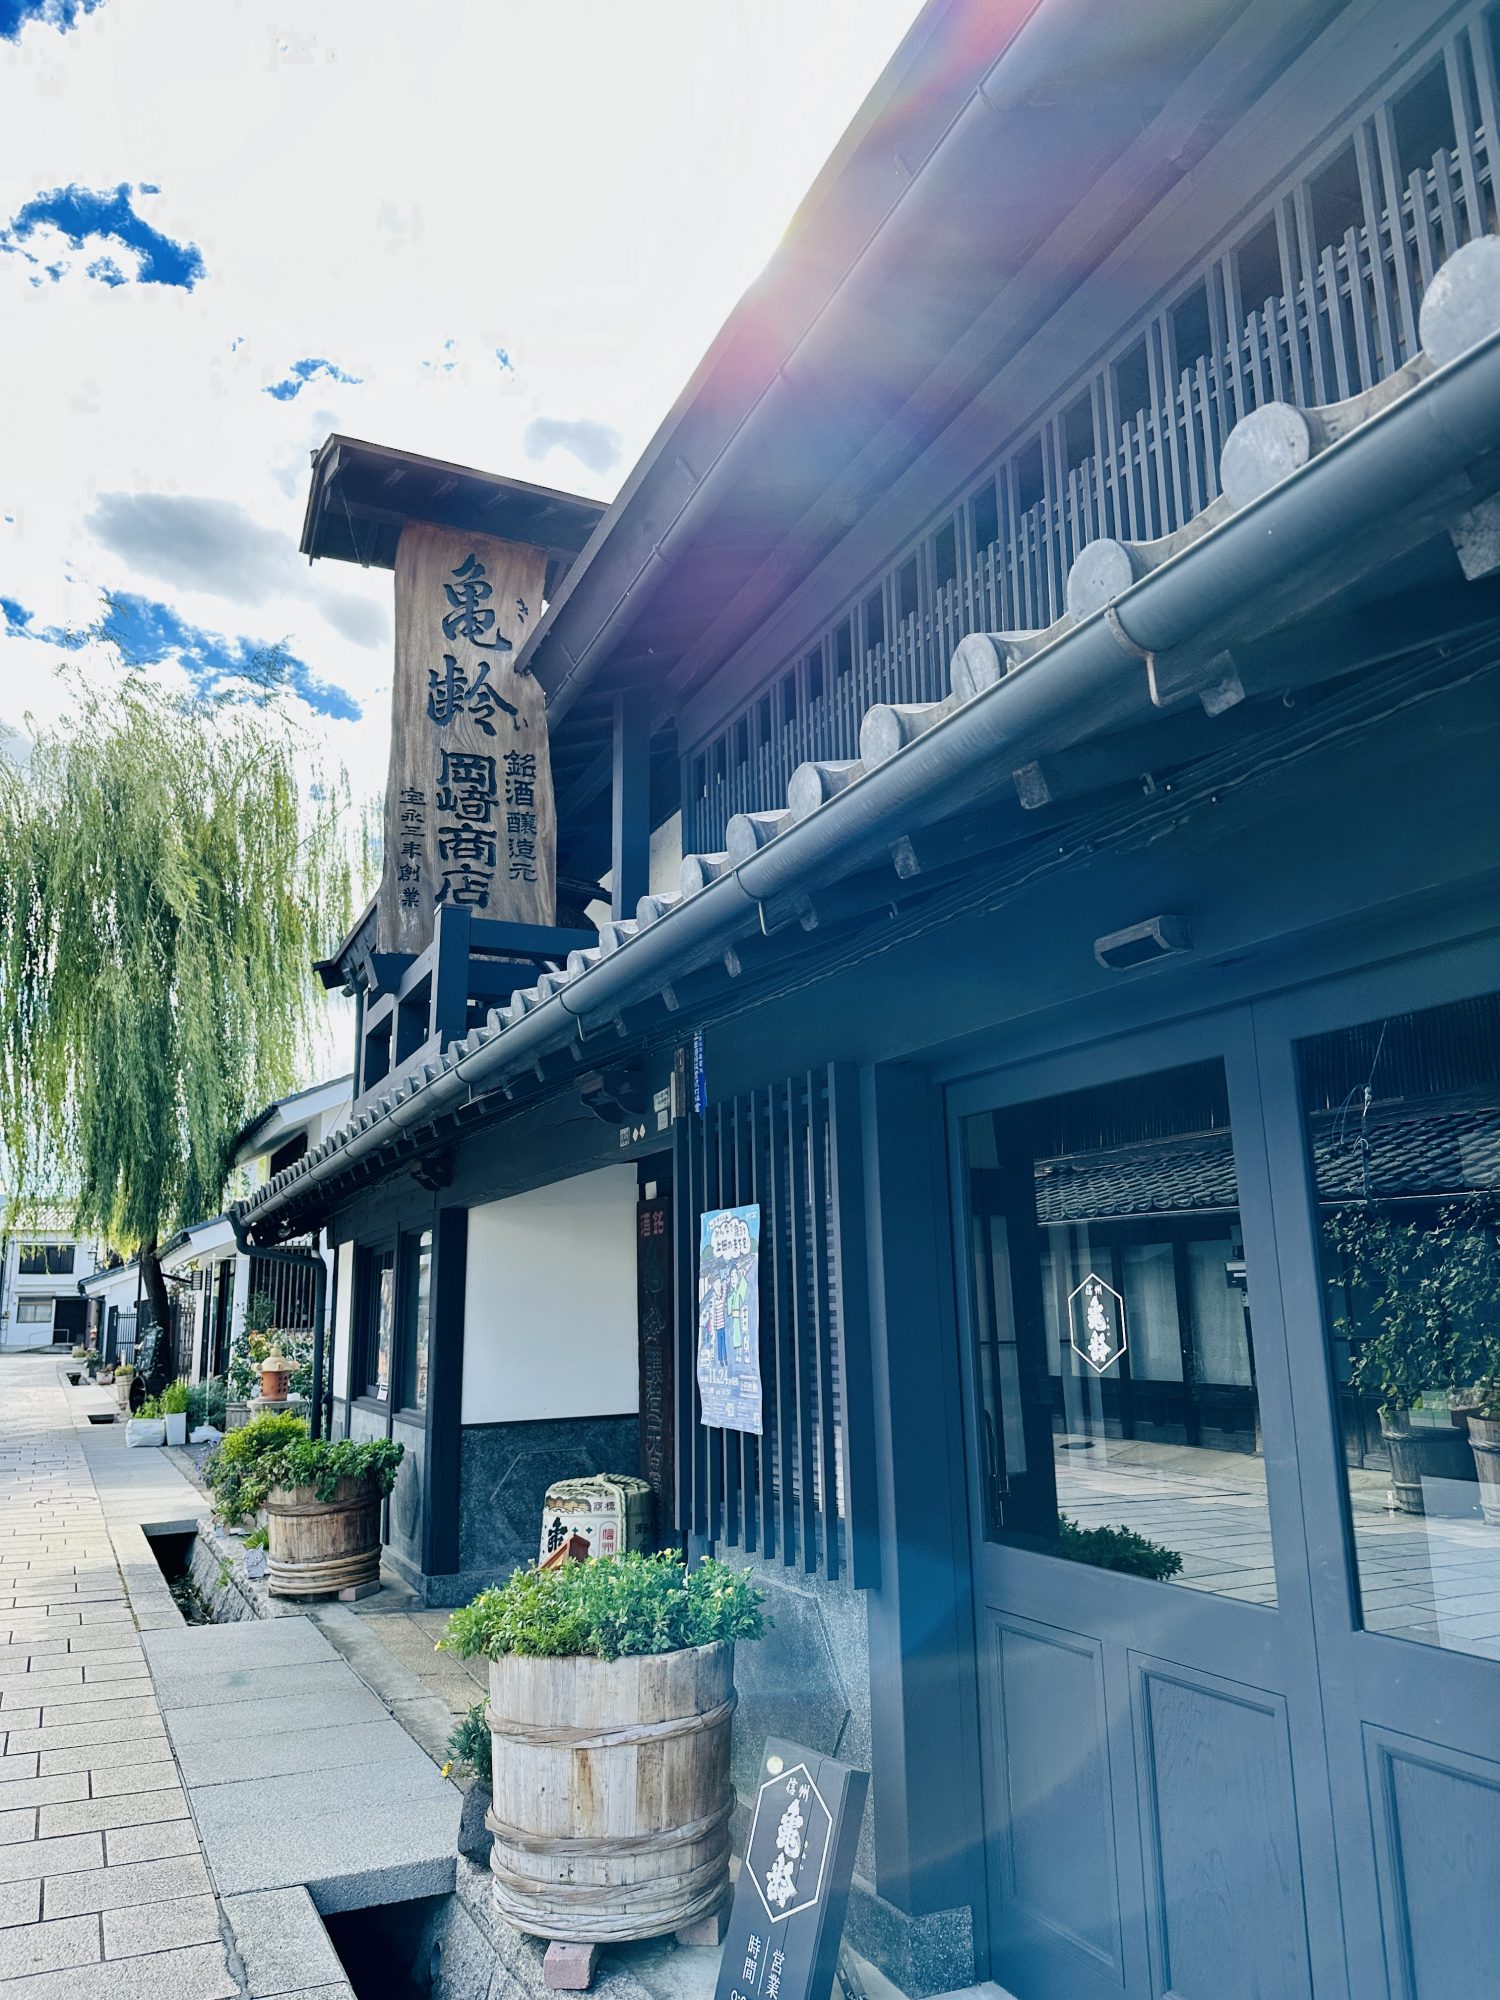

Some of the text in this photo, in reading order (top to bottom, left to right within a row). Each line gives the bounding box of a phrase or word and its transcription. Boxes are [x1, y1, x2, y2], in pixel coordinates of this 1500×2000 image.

[428, 553, 513, 737] 亀齢
[503, 749, 538, 883] 銘酒醸造元
[602, 1528, 615, 1553] 信州
[786, 1777, 811, 1803] 信州
[742, 1933, 762, 1985] 時間
[765, 1949, 785, 2000] 営業
